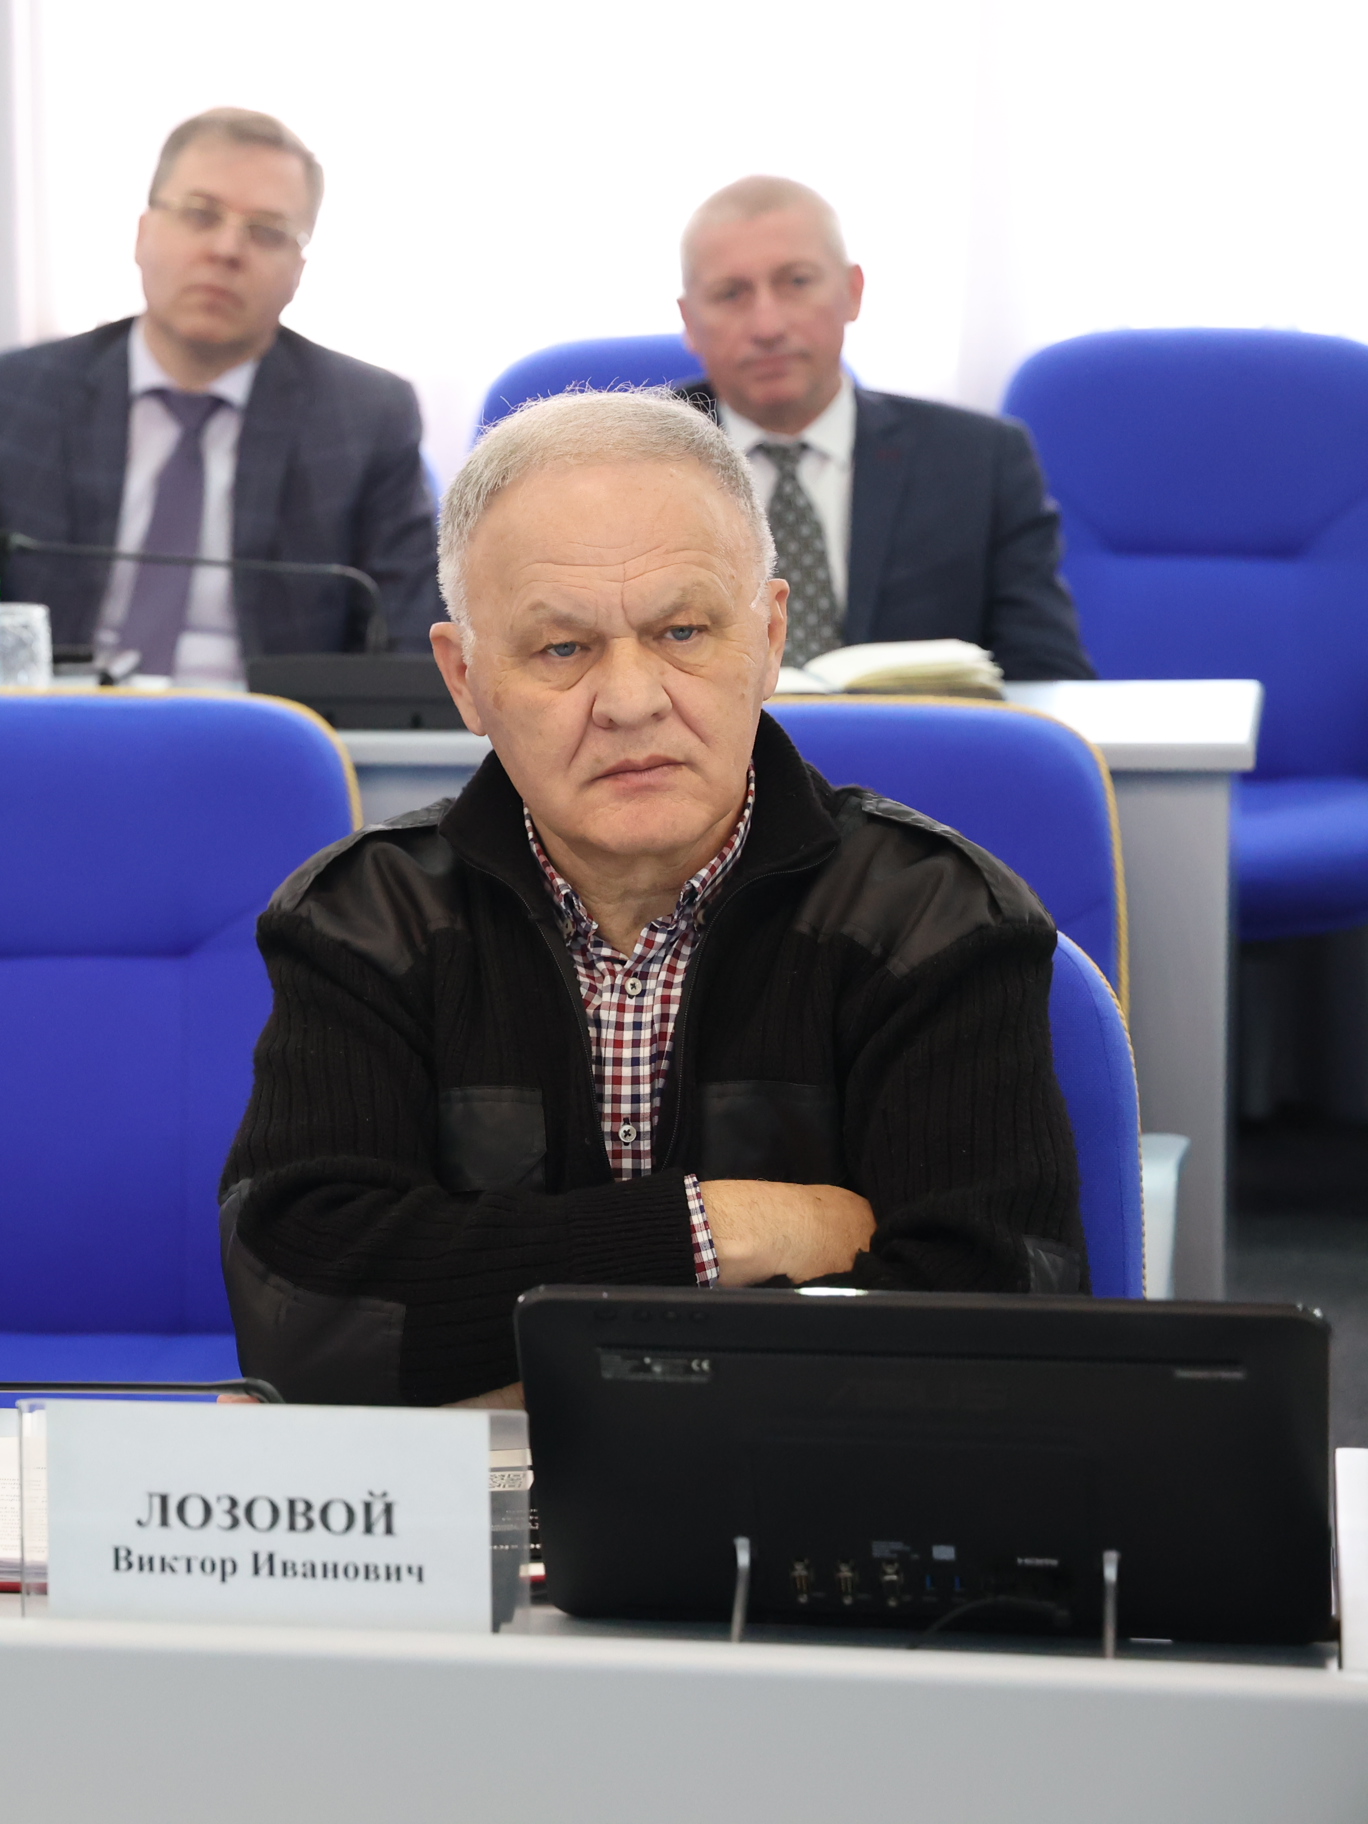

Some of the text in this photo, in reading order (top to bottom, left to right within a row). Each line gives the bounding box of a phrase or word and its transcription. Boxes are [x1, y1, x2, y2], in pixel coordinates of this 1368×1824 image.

[135, 1490, 398, 1538] ЛОЗОВОЙ
[111, 1545, 425, 1584] Виктор Иванович
